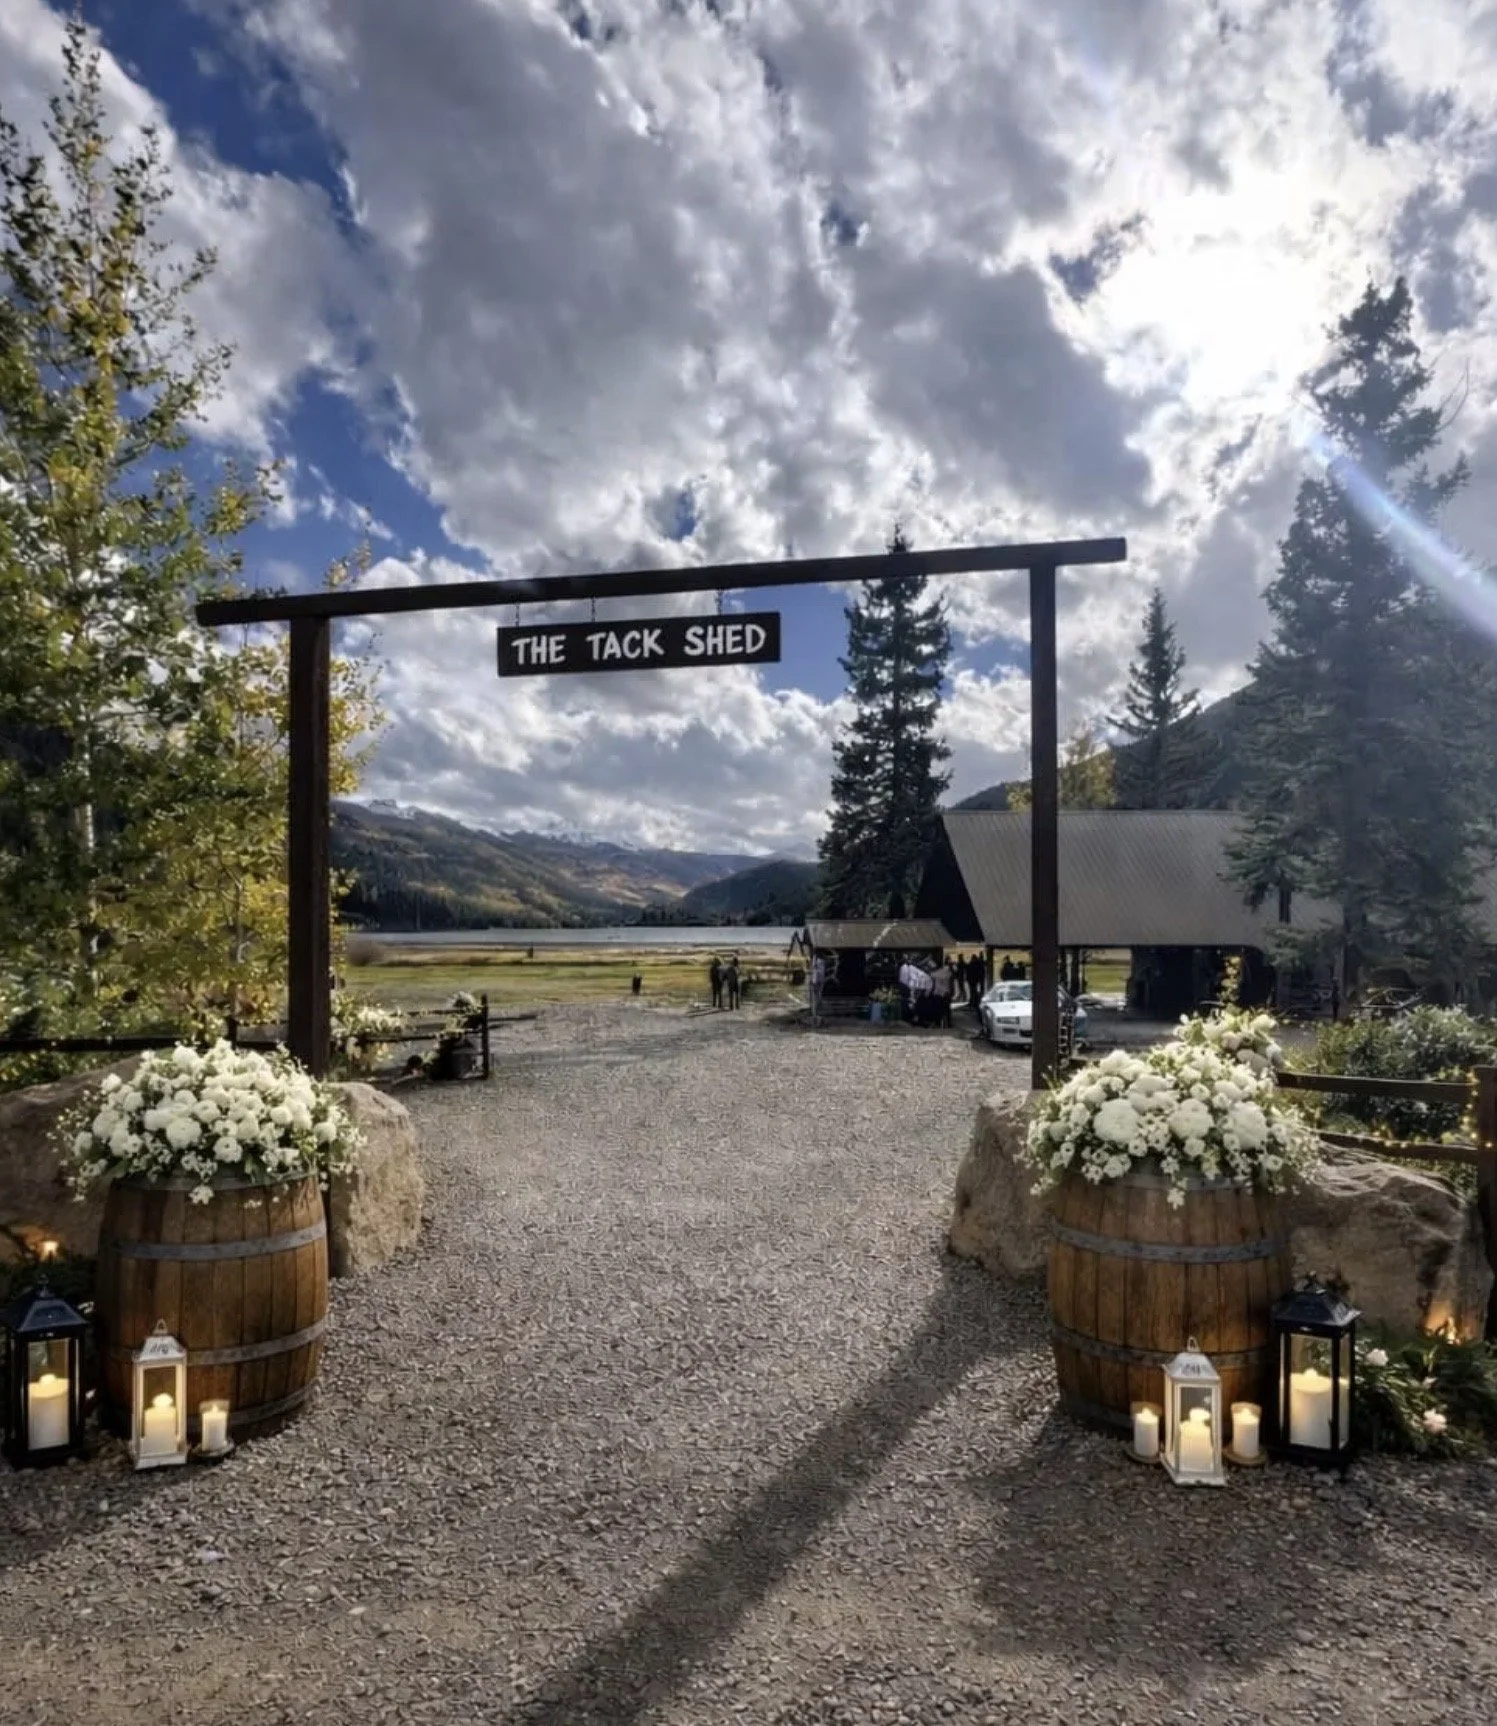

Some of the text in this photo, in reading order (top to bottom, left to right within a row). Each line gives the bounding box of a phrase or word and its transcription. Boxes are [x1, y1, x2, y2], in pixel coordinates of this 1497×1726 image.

[511, 624, 766, 665] THE TACK SHED
